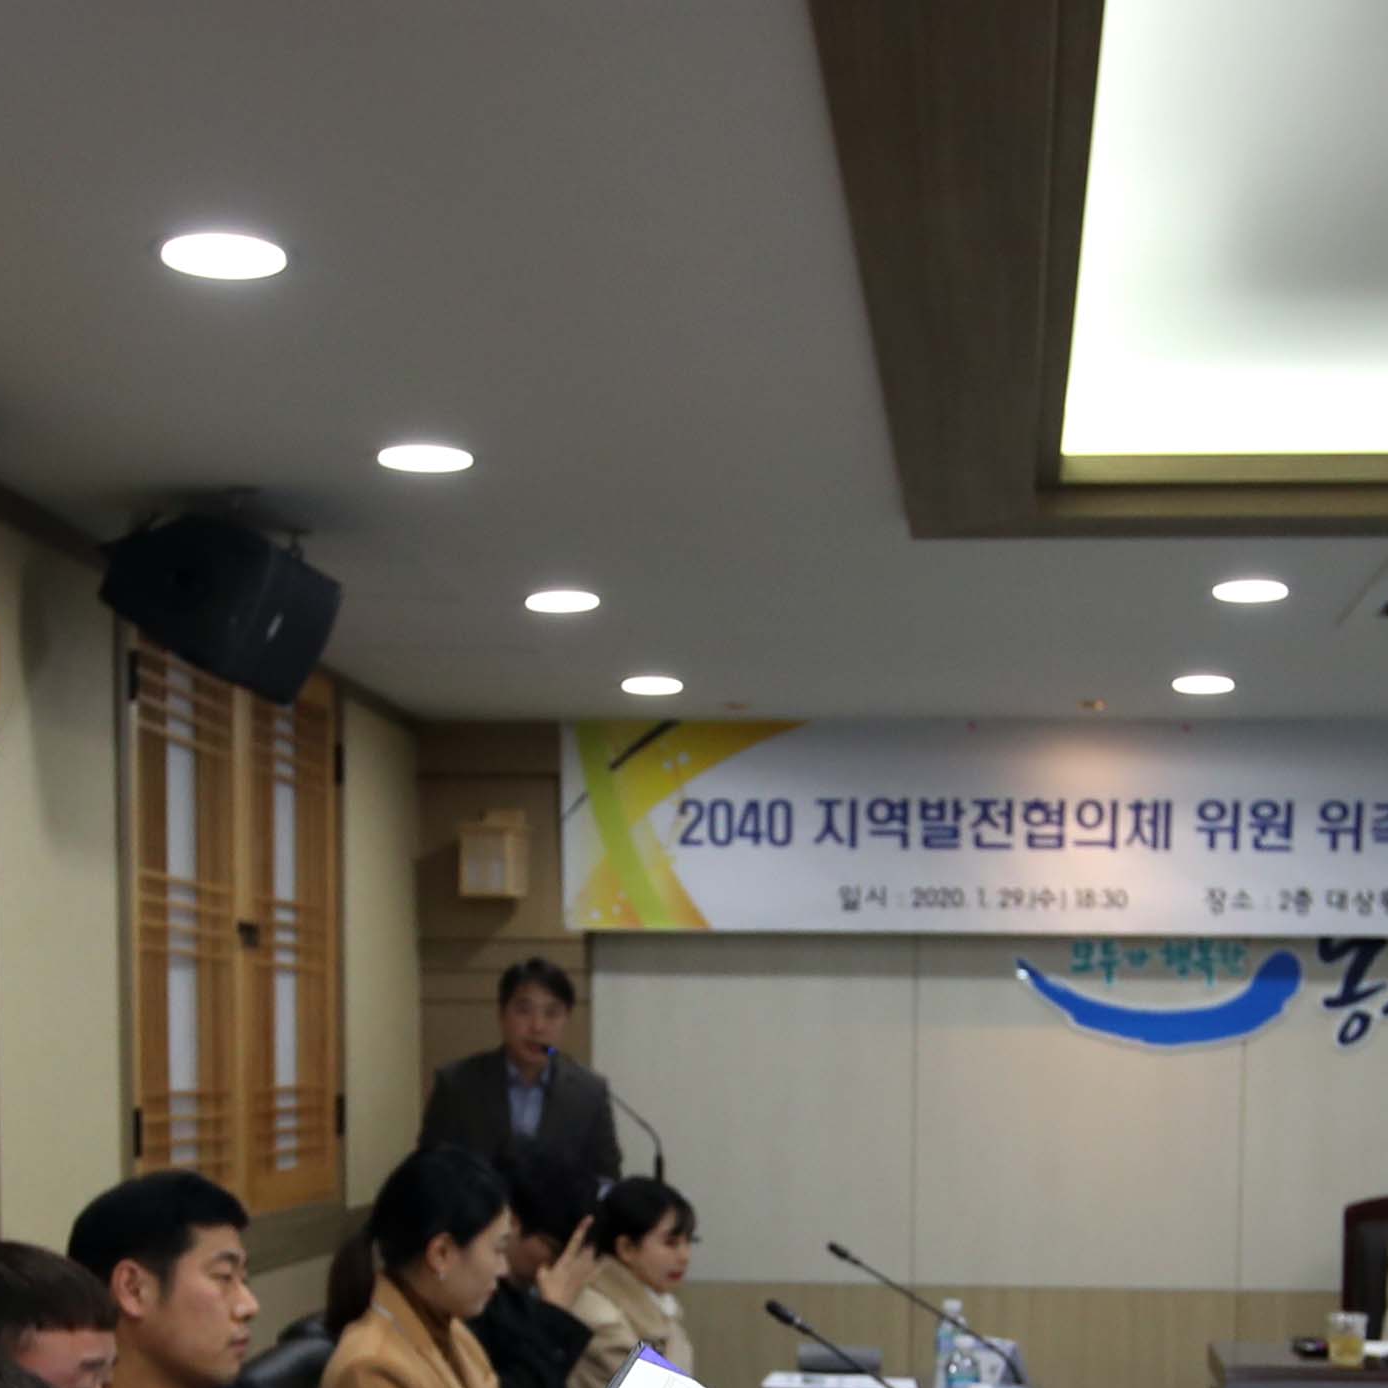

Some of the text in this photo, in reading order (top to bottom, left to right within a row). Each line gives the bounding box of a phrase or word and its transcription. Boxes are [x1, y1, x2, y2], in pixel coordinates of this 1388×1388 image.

[679, 799, 794, 847] 2040
[814, 798, 1173, 851] 지역발전협의체
[1196, 800, 1295, 853] 위원
